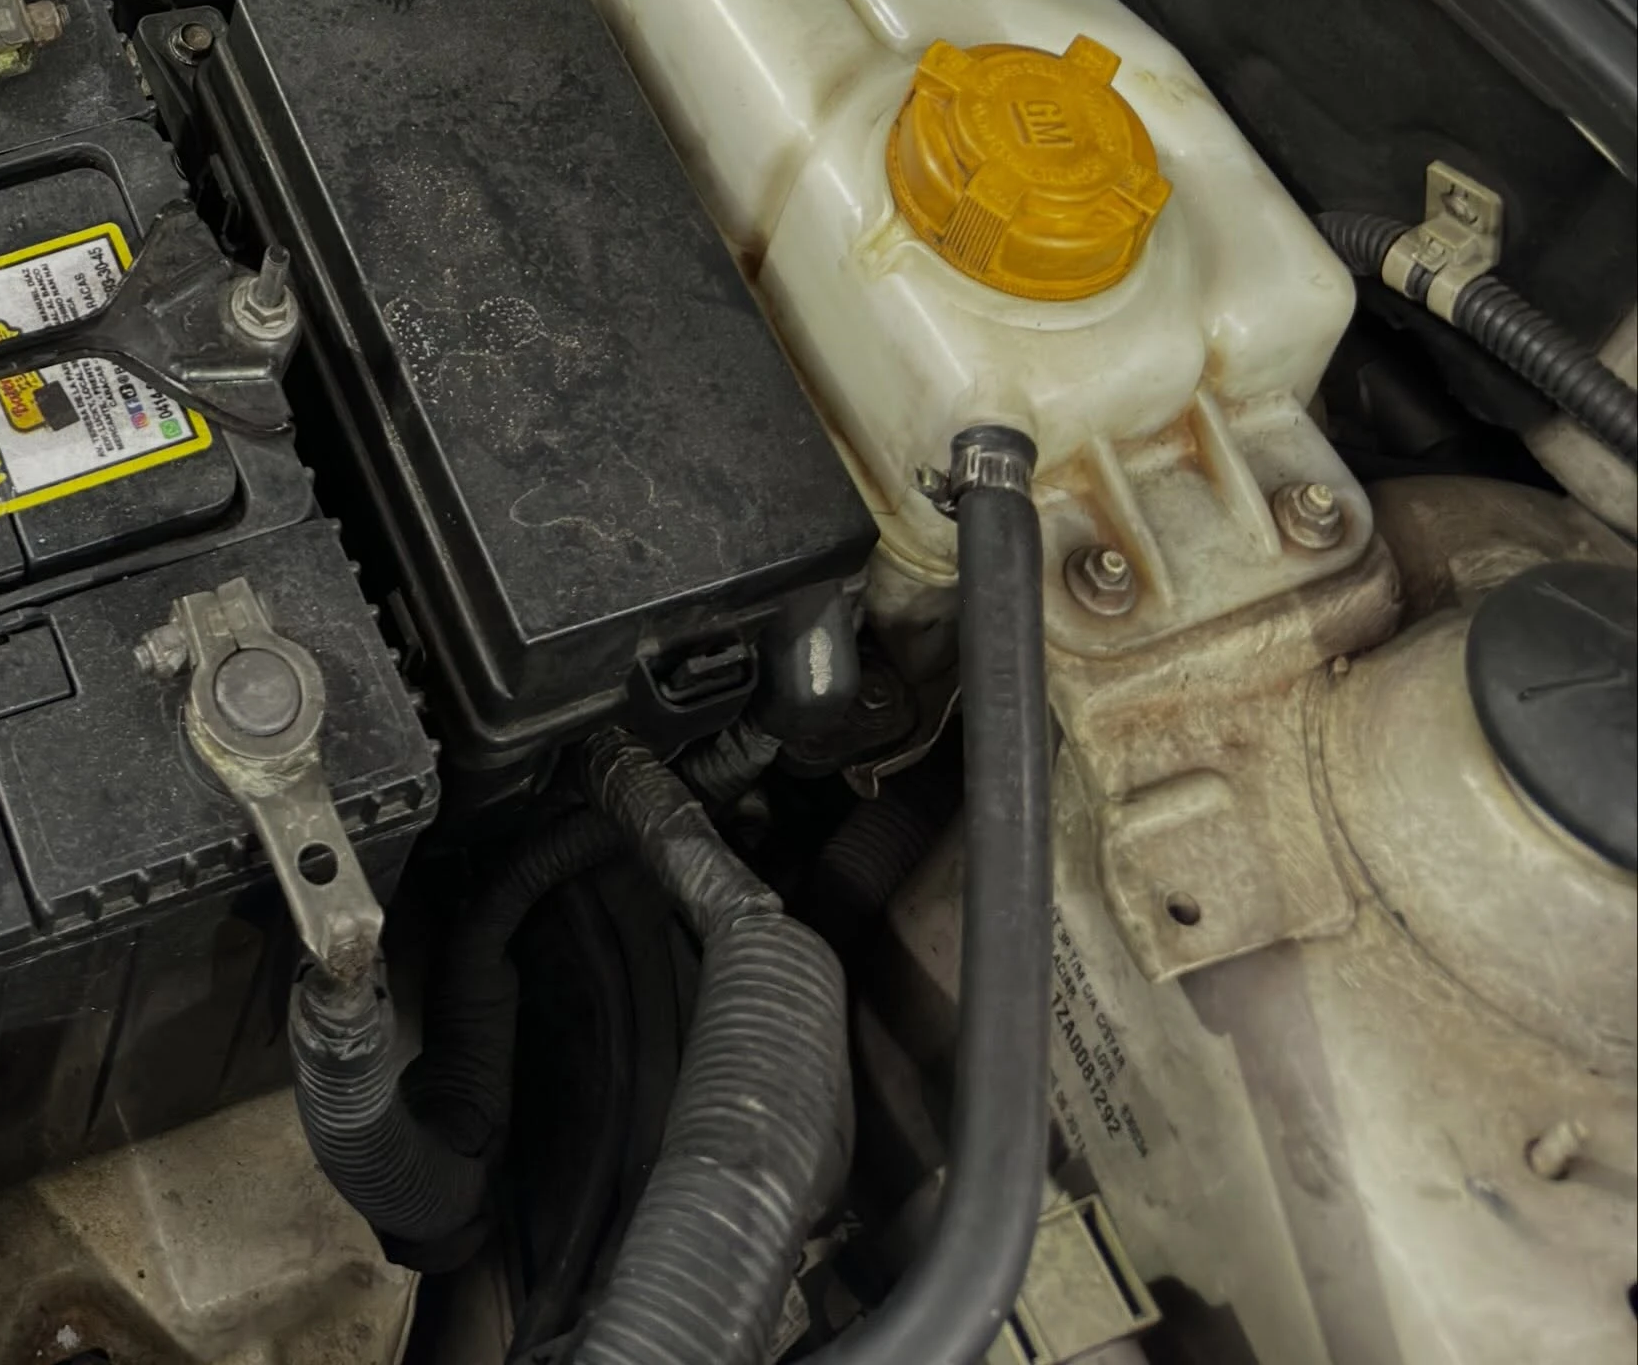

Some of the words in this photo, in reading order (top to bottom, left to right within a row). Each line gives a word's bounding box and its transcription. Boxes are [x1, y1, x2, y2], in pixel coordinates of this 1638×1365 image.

[1024, 98, 1075, 150] GM
[31, 266, 50, 297] BANCO
[72, 271, 98, 311] RACAS
[29, 288, 50, 322] MANUEL
[60, 362, 75, 382] PAR
[68, 382, 80, 395] LA
[81, 360, 102, 395] FRENTE
[93, 364, 118, 408] CARACAS
[73, 393, 85, 408] DE
[78, 407, 100, 443] TERESA
